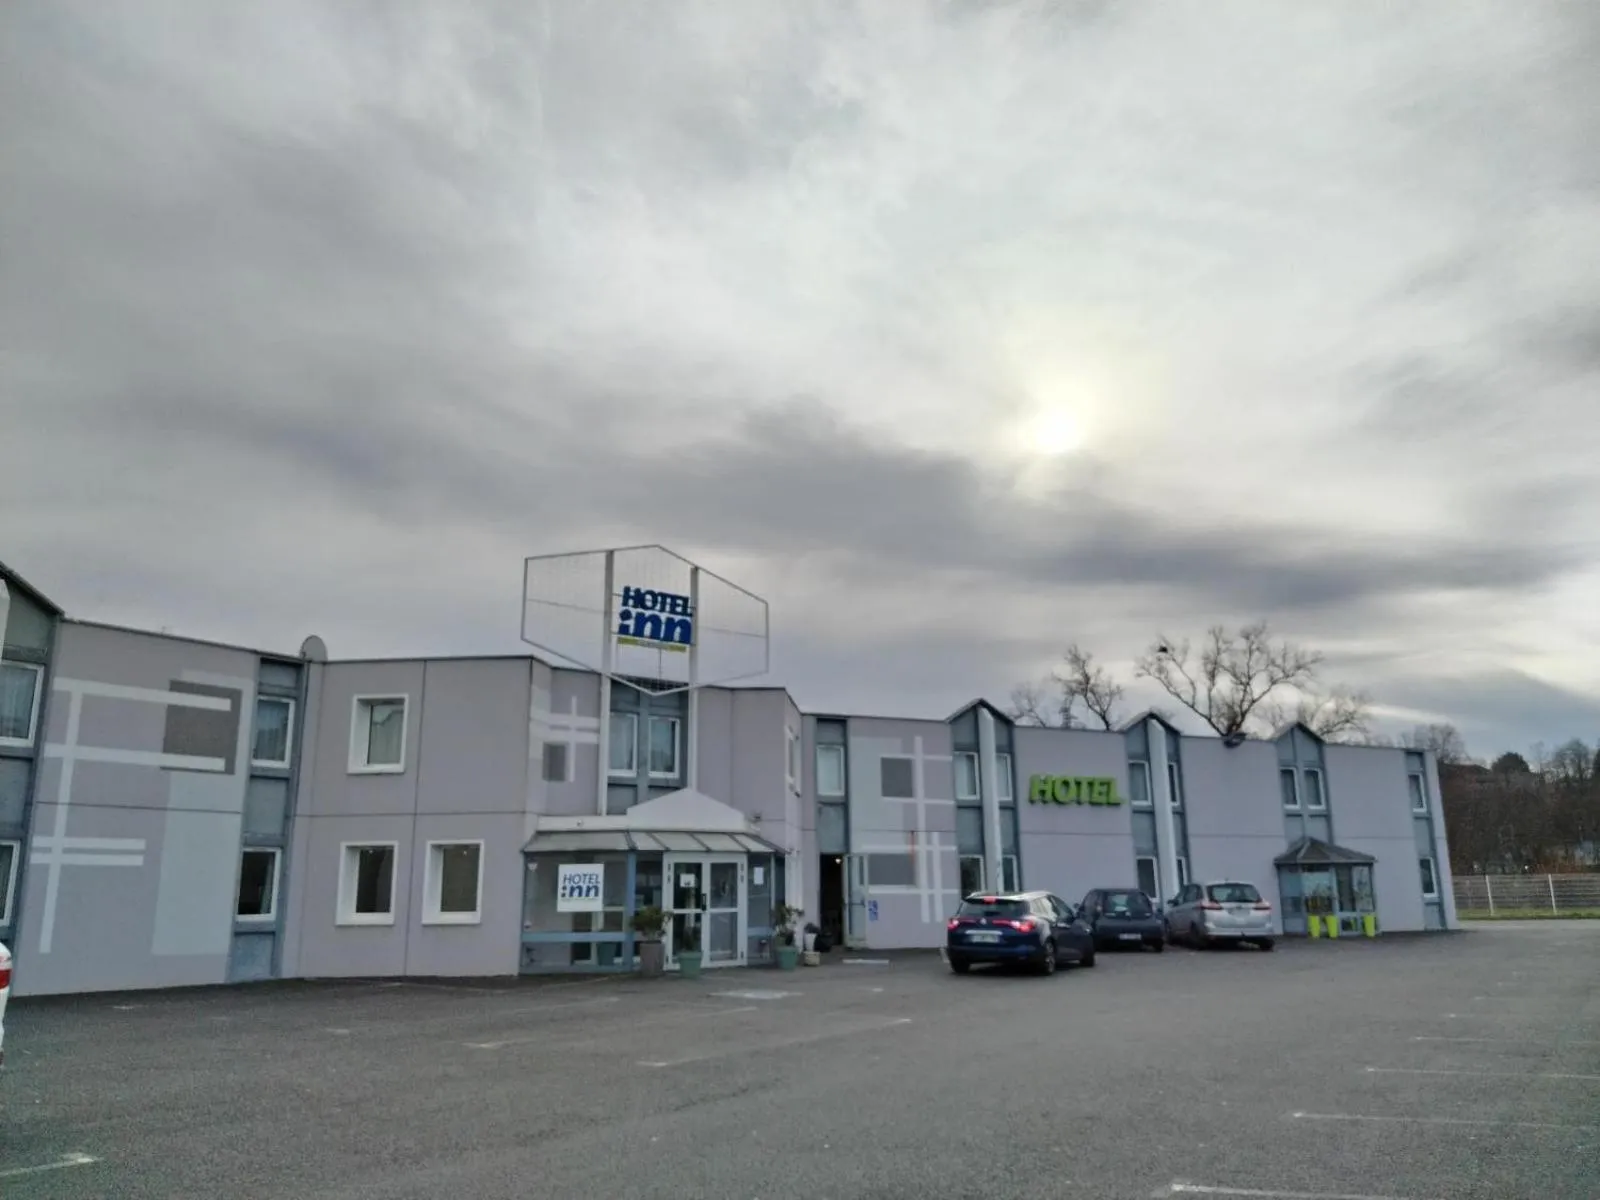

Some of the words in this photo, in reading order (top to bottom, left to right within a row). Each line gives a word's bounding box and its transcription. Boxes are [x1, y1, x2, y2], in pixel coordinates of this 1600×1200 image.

[622, 586, 693, 617] HOTEL
[618, 609, 693, 645] inn
[1028, 774, 1122, 806] HOTEL
[561, 884, 599, 898] inn
[563, 873, 600, 885] HOTEL
